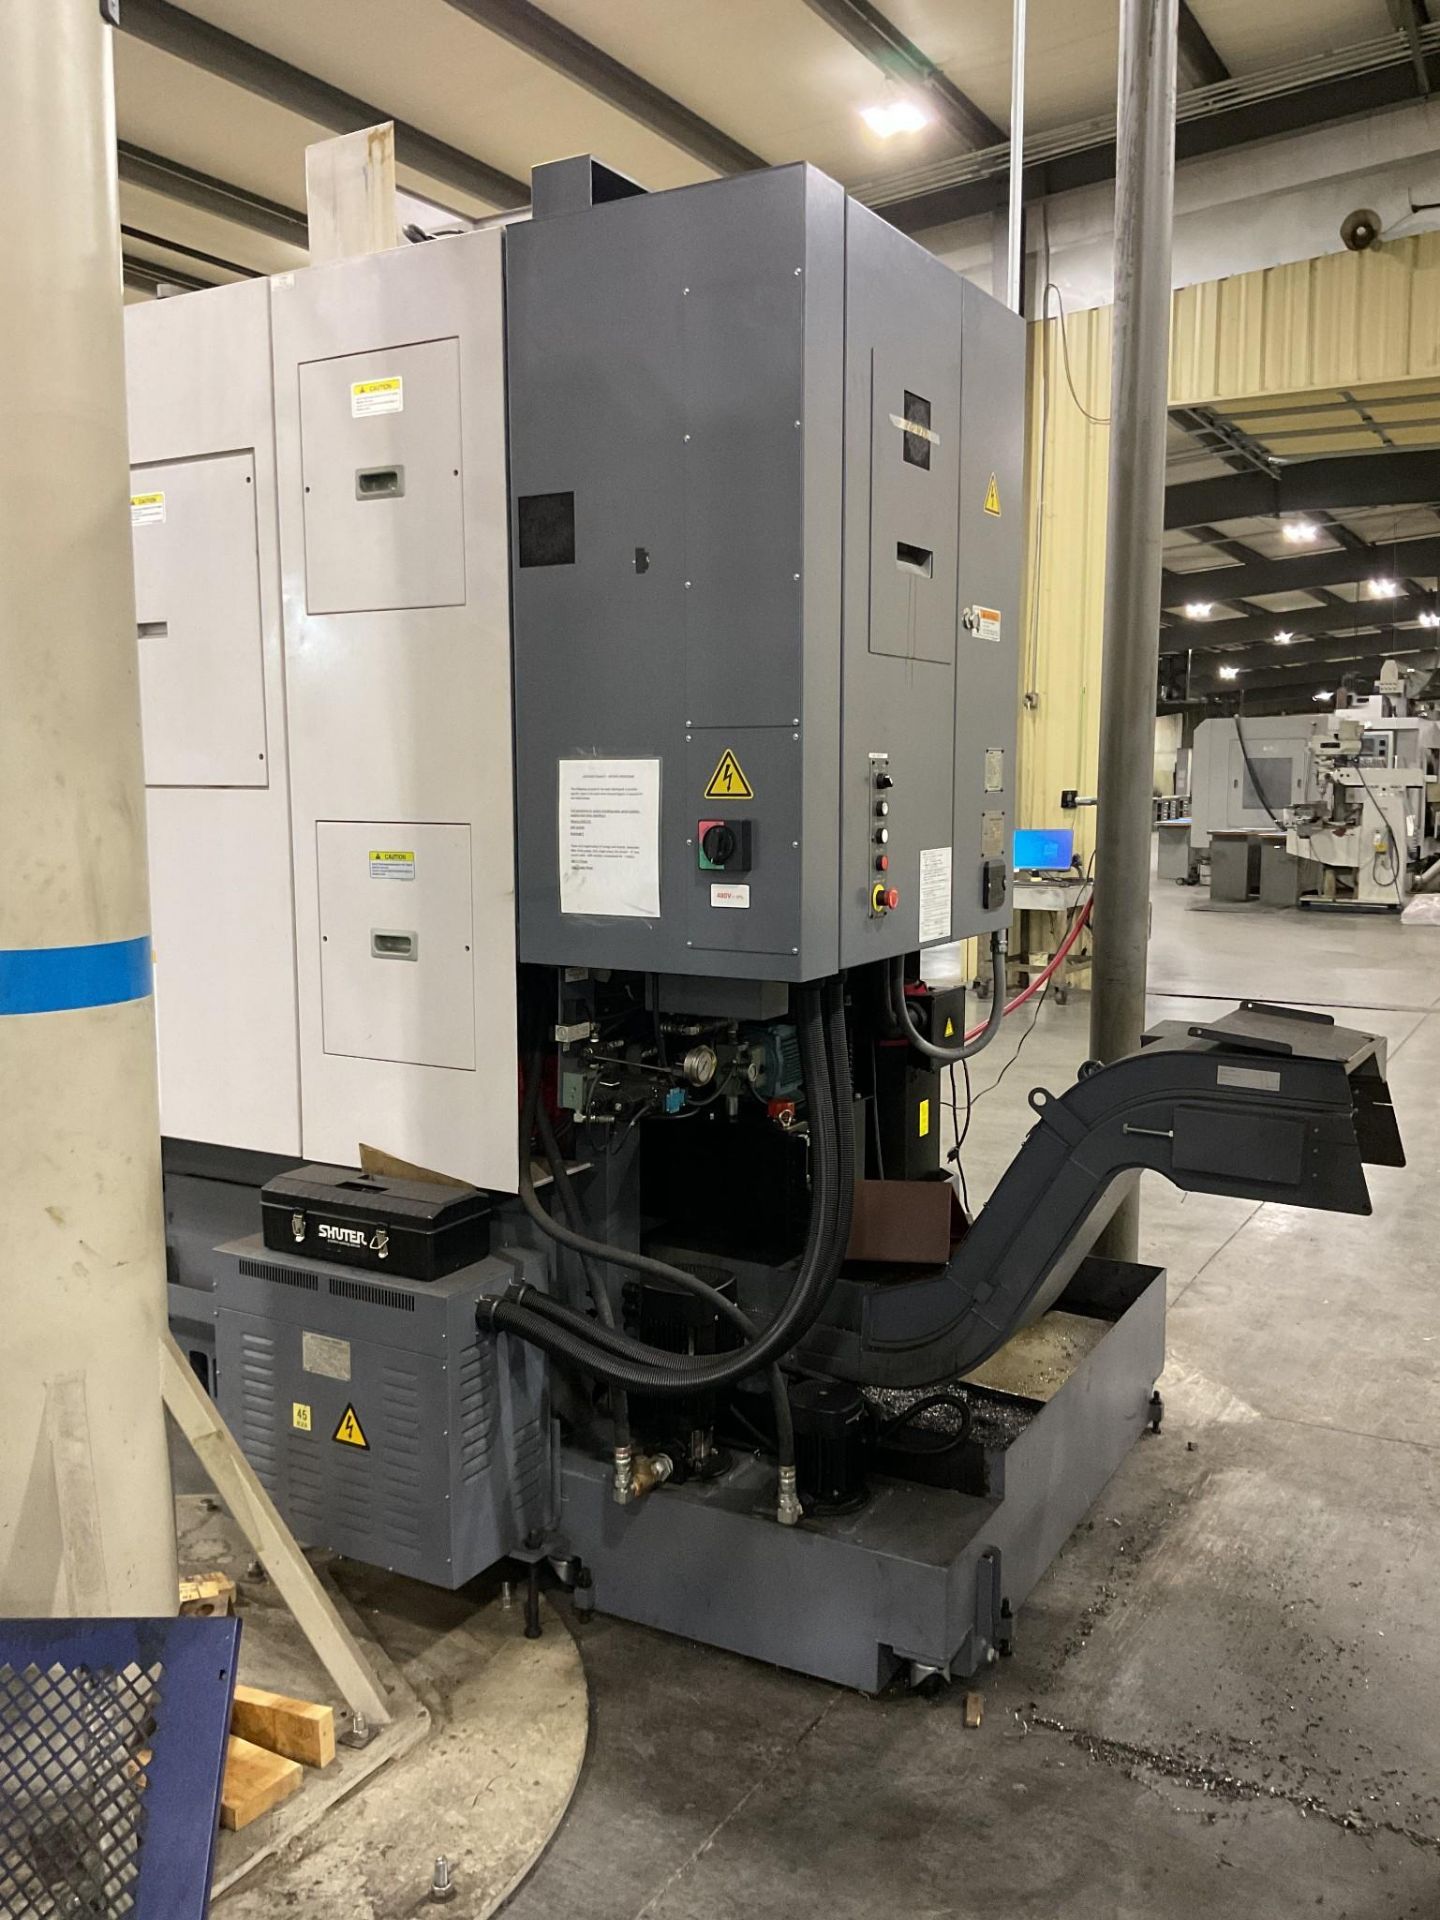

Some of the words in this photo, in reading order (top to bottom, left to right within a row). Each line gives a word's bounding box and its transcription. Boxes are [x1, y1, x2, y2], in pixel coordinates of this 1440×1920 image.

[369, 384, 392, 392] CAUTION
[318, 1224, 368, 1246] SHUTER
[297, 1409, 308, 1421] 45
